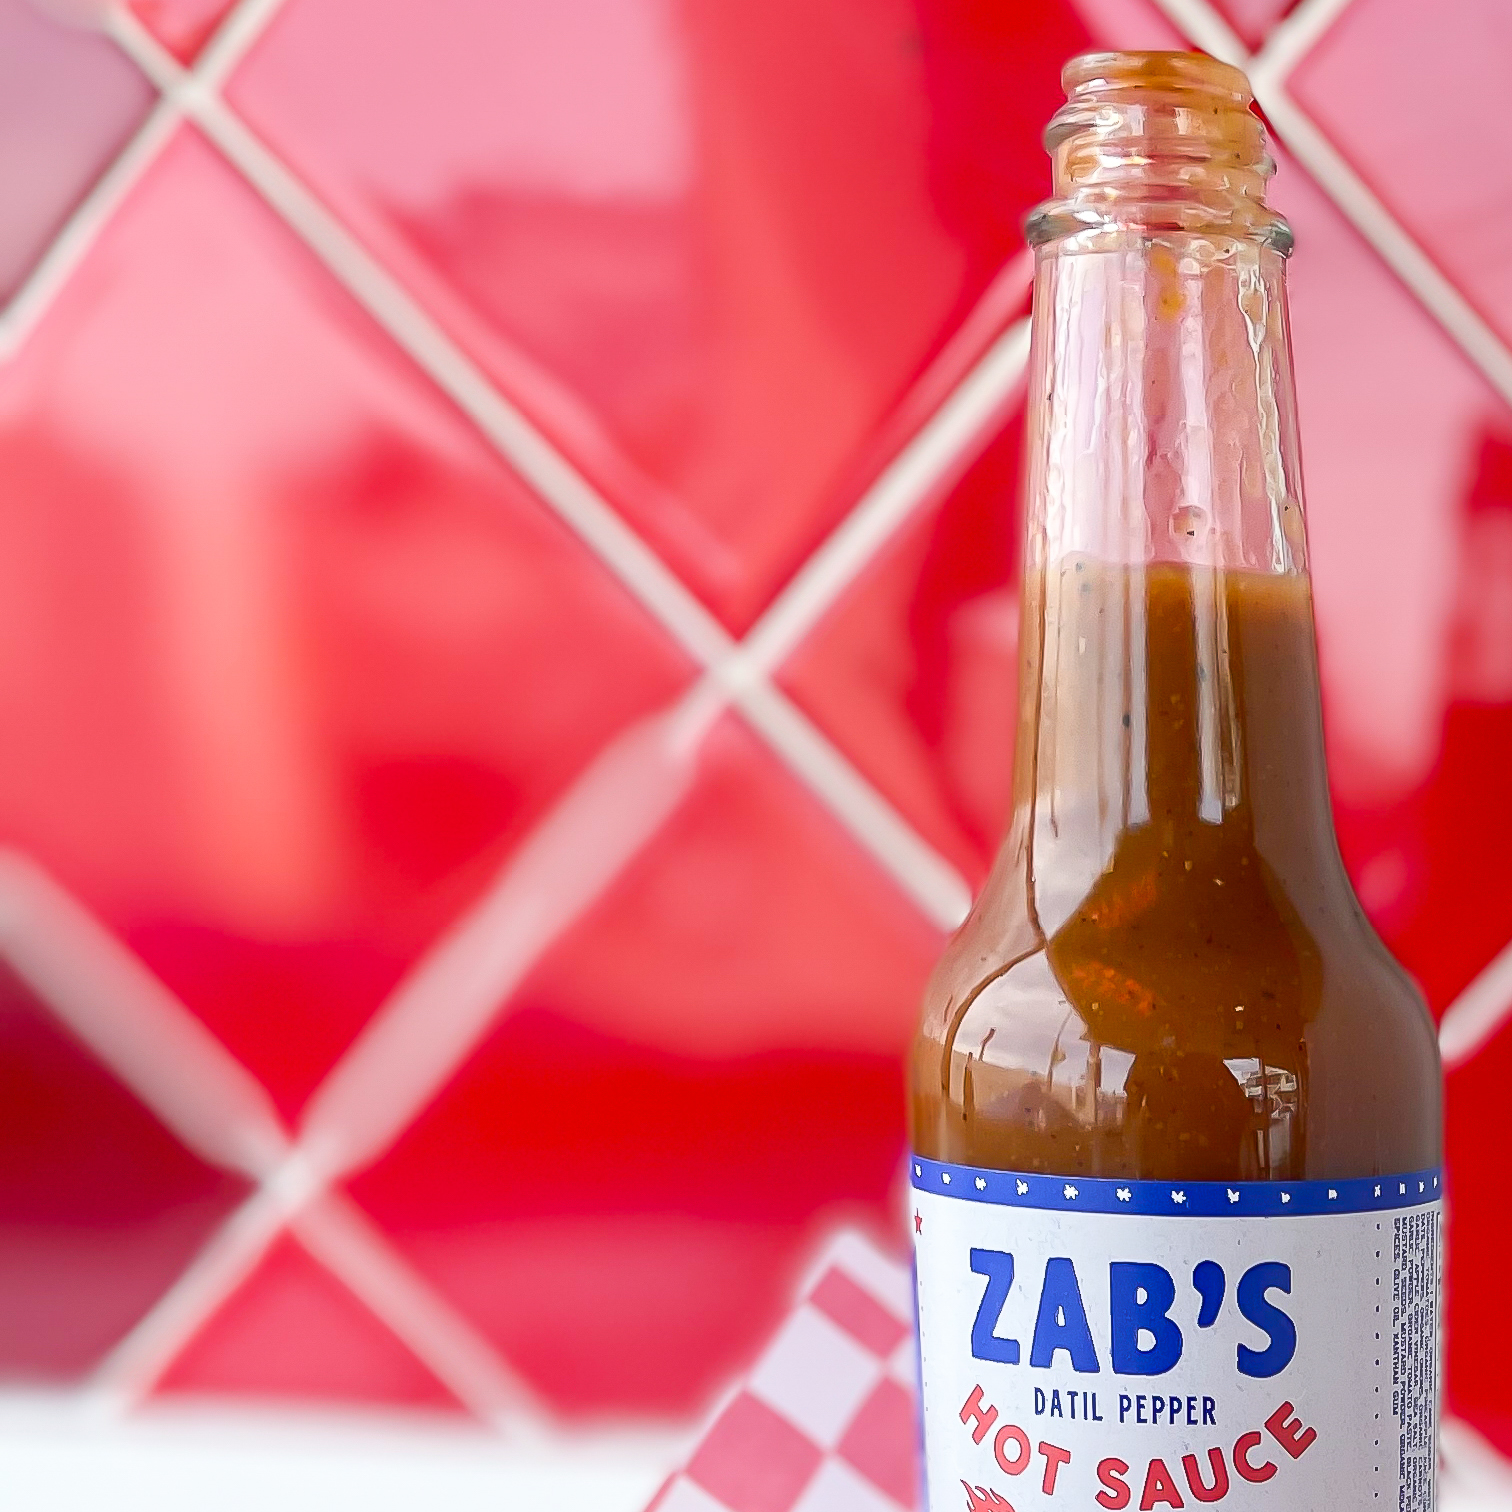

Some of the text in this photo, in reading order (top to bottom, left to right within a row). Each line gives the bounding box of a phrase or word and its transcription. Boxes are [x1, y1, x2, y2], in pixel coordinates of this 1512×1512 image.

[969, 1246, 1298, 1379] ZAB'S
[959, 1383, 1318, 1512] HOT SAUCE
[1033, 1386, 1217, 1427] DATIL PEPPER
